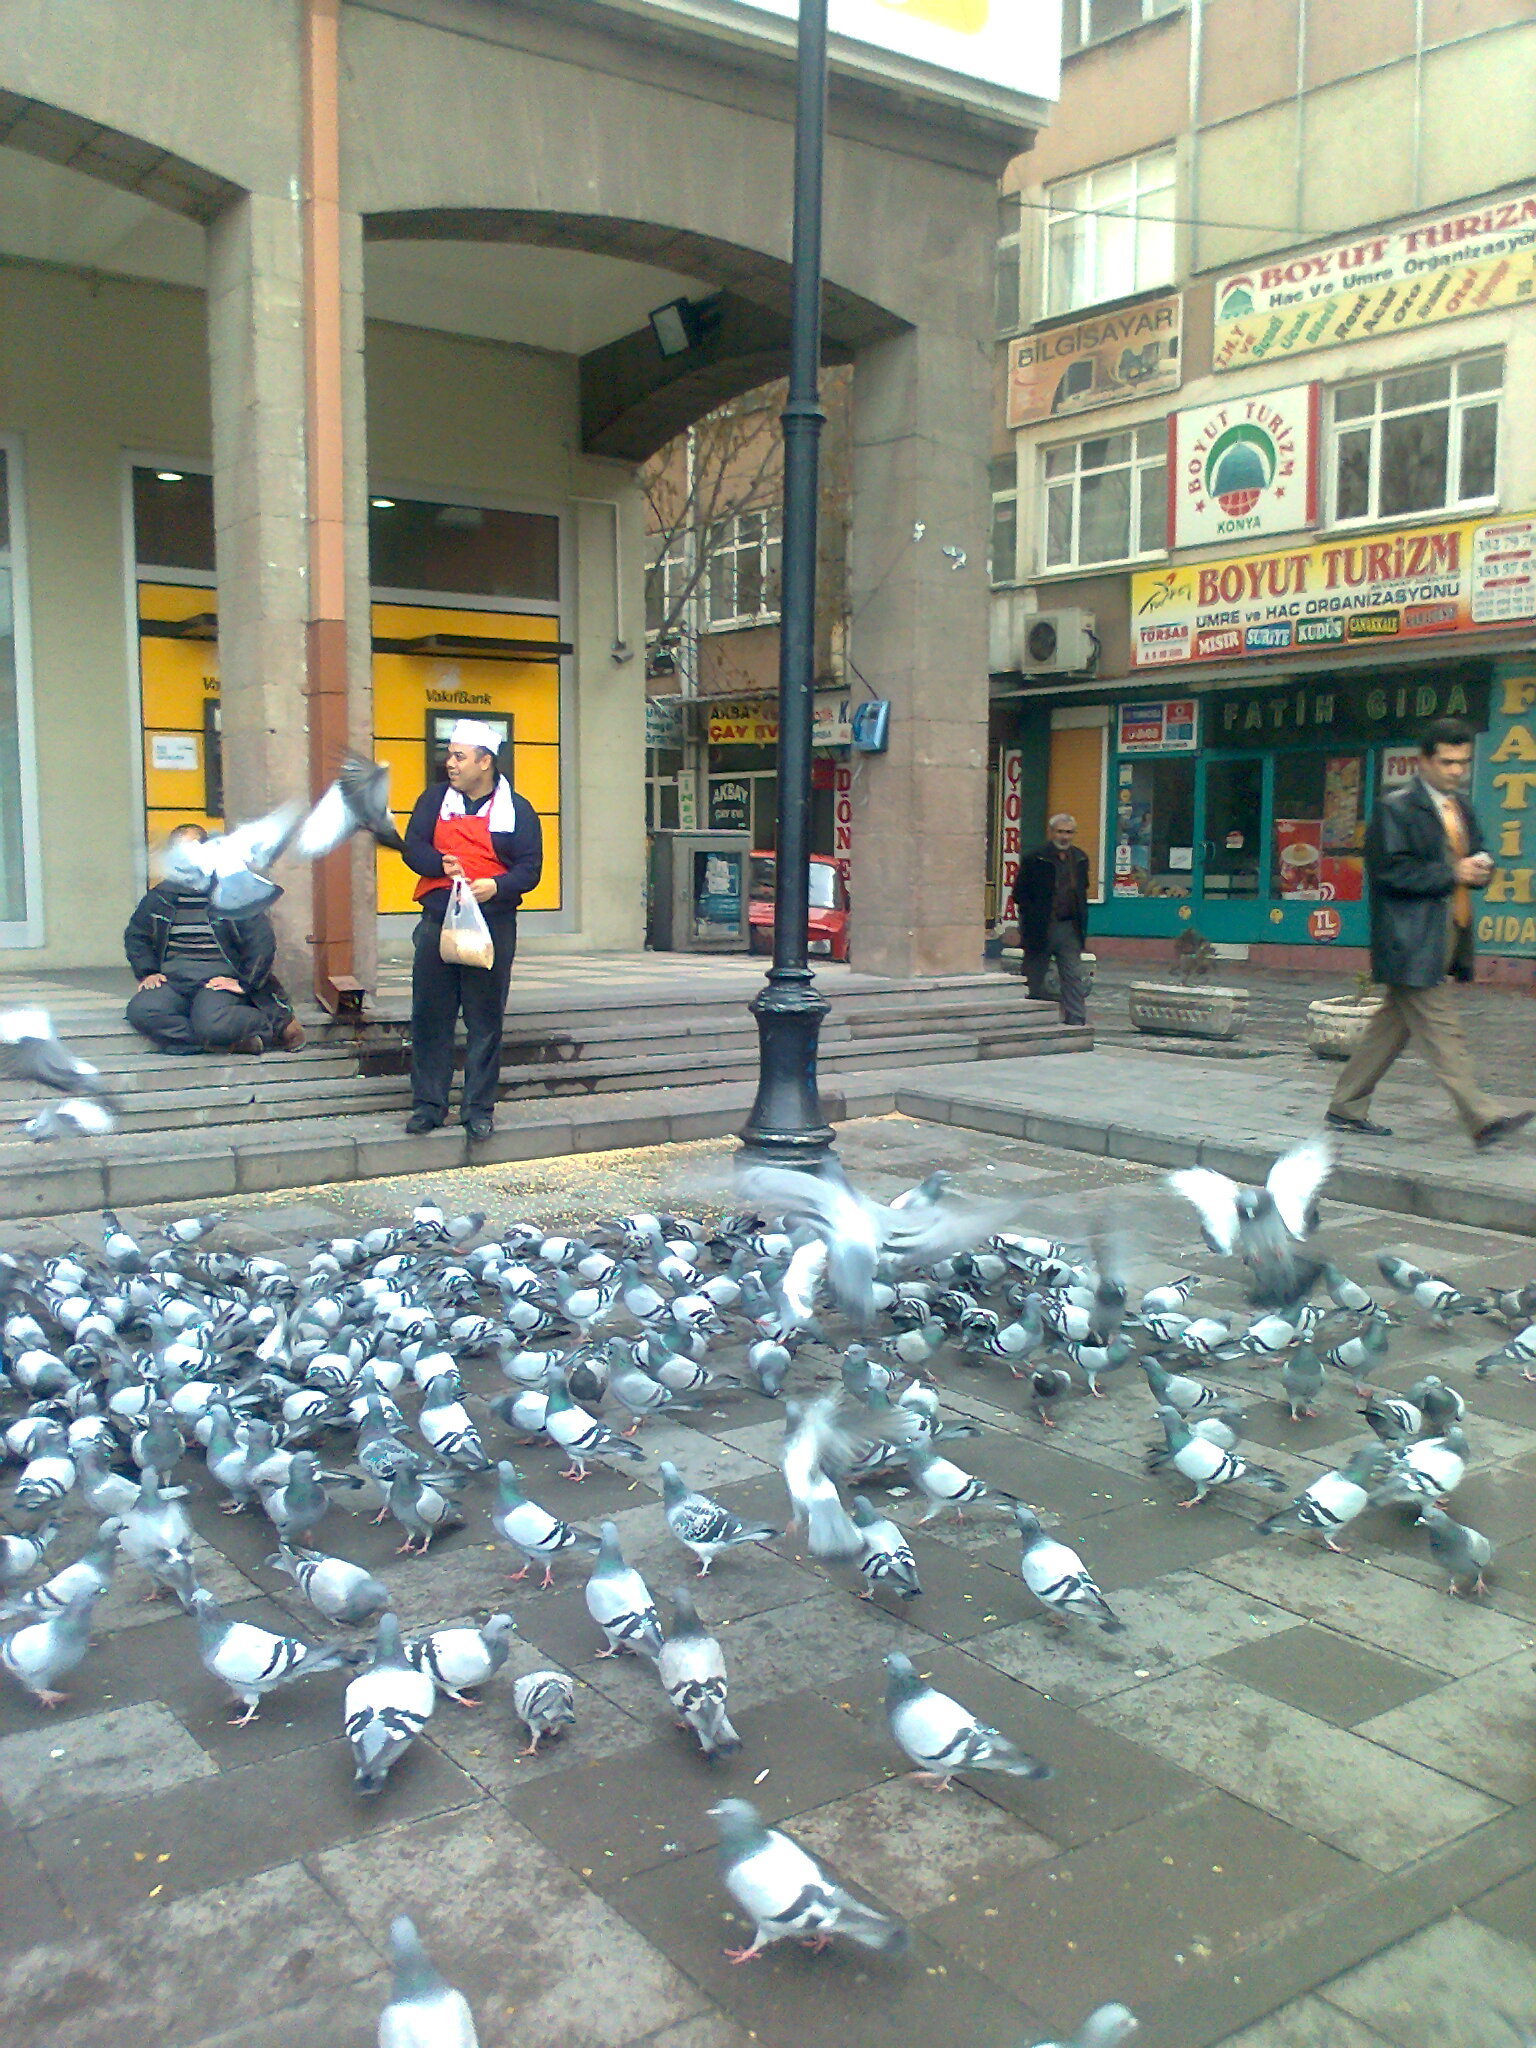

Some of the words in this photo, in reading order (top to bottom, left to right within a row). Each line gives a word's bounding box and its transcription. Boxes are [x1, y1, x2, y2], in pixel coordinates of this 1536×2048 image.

[1260, 236, 1389, 290] BOYUT
[1269, 290, 1304, 307] Hac
[1343, 267, 1393, 290] Umre
[1017, 307, 1174, 368] BİLGİSAYAR
[1187, 410, 1229, 493] BOYUT
[1217, 516, 1261, 533] KONYA
[1197, 554, 1312, 608] BOYUT
[1323, 532, 1460, 590] TURİZM
[1196, 611, 1240, 628] UMRE
[1266, 603, 1301, 619] HAC
[1366, 684, 1468, 720] GIDA
[1387, 755, 1419, 776] FOT
[836, 768, 851, 881] DÖNE
[1313, 911, 1337, 928] TL
[1477, 915, 1536, 944] GIDA
